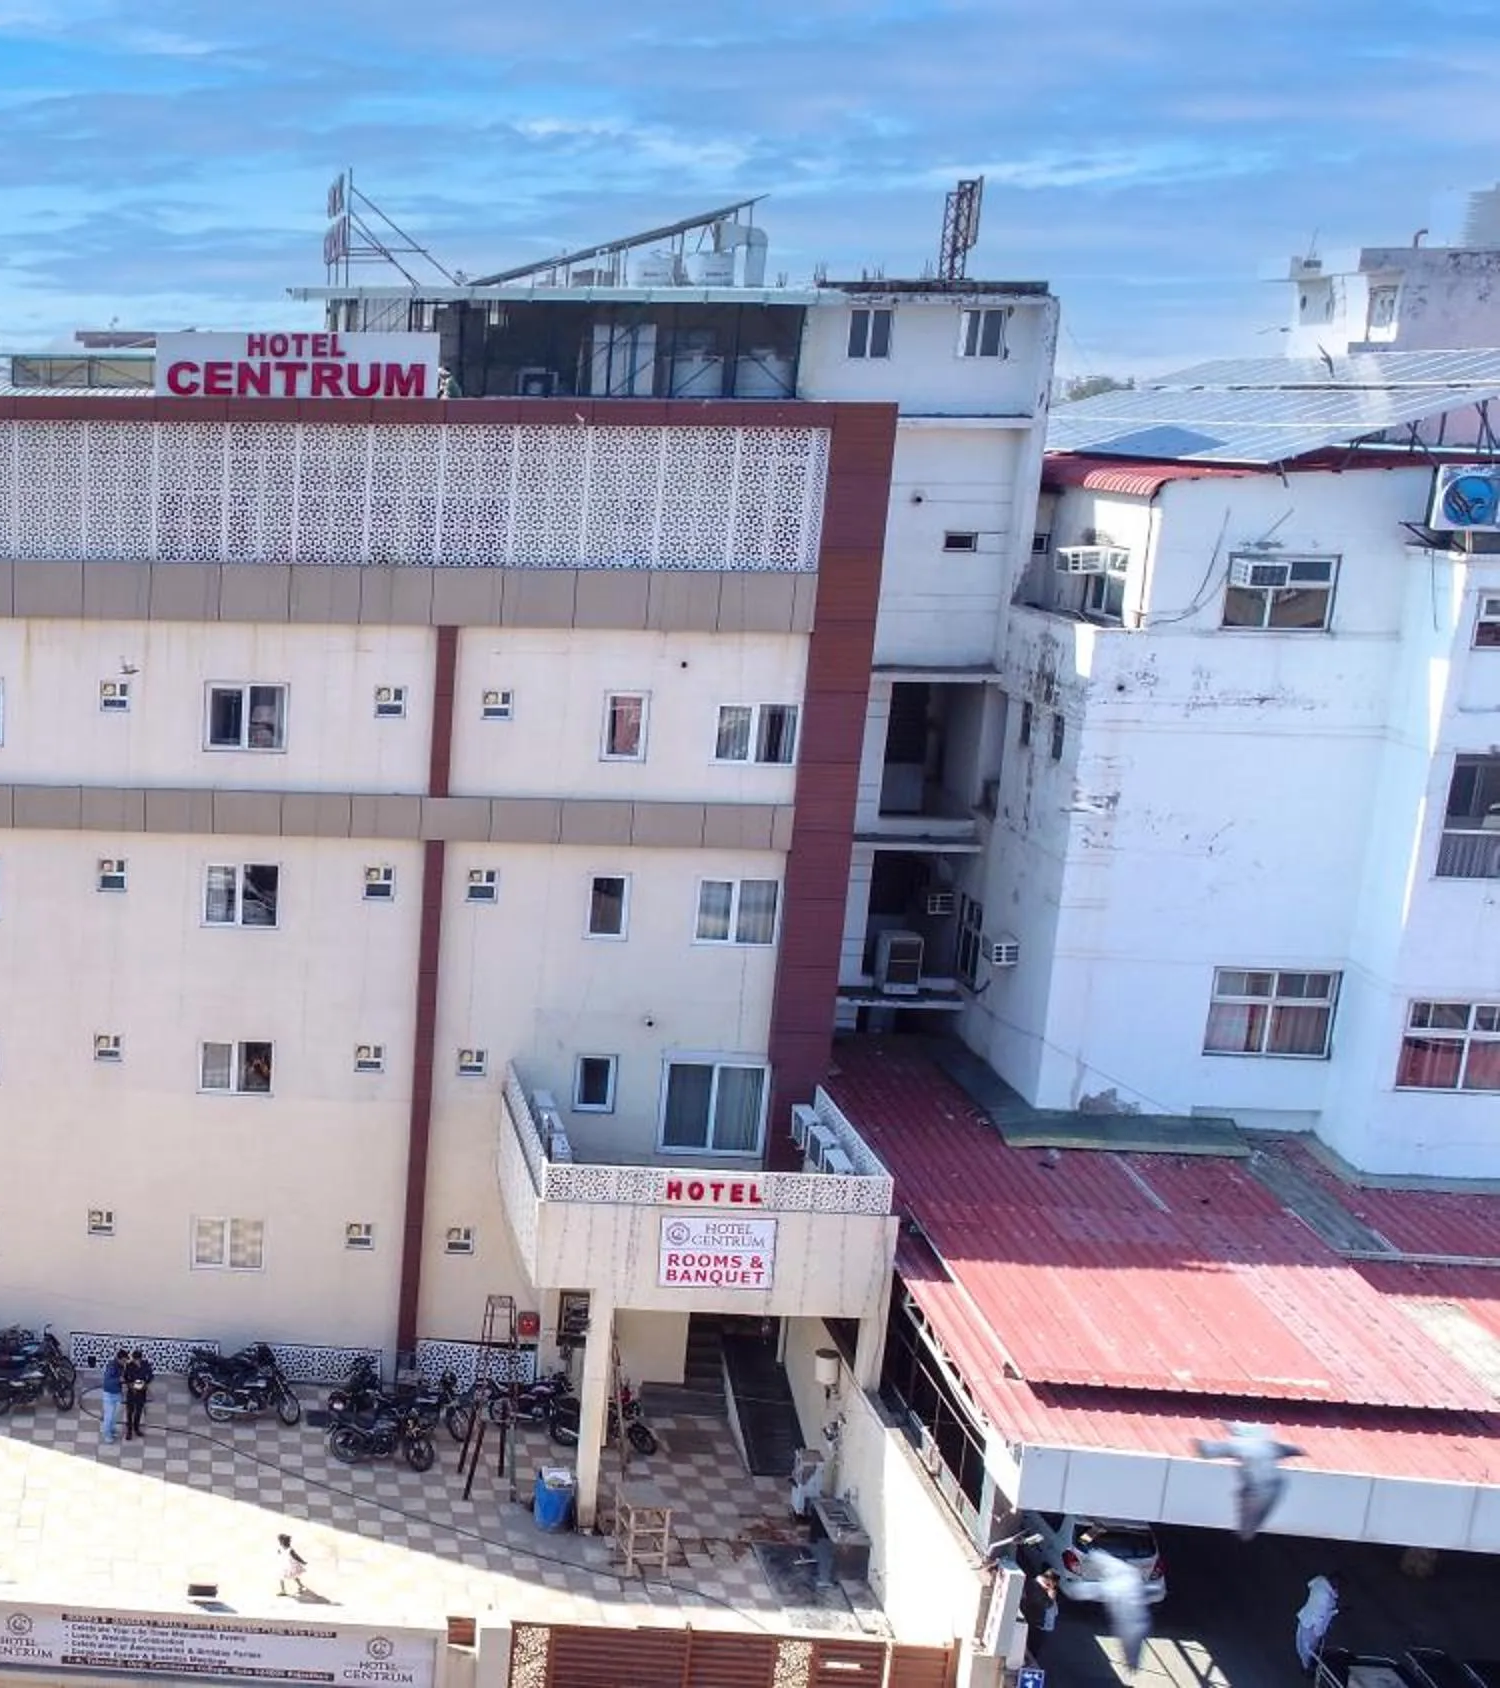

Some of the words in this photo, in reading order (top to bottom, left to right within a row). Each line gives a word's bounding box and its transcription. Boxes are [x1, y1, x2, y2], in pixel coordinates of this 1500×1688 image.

[247, 334, 346, 358] HOTEL
[167, 362, 426, 397] CENTRUM
[666, 1181, 763, 1204] HOTEL
[705, 1223, 754, 1235] HOTEL
[691, 1235, 765, 1247] CENTRUM
[667, 1253, 742, 1269] ROOMS
[750, 1255, 764, 1270] &
[665, 1269, 765, 1287] BANQUET
[0, 1636, 36, 1646] HOTEL
[359, 1661, 398, 1671] HOTEL
[343, 1669, 413, 1683] CENTRUM
